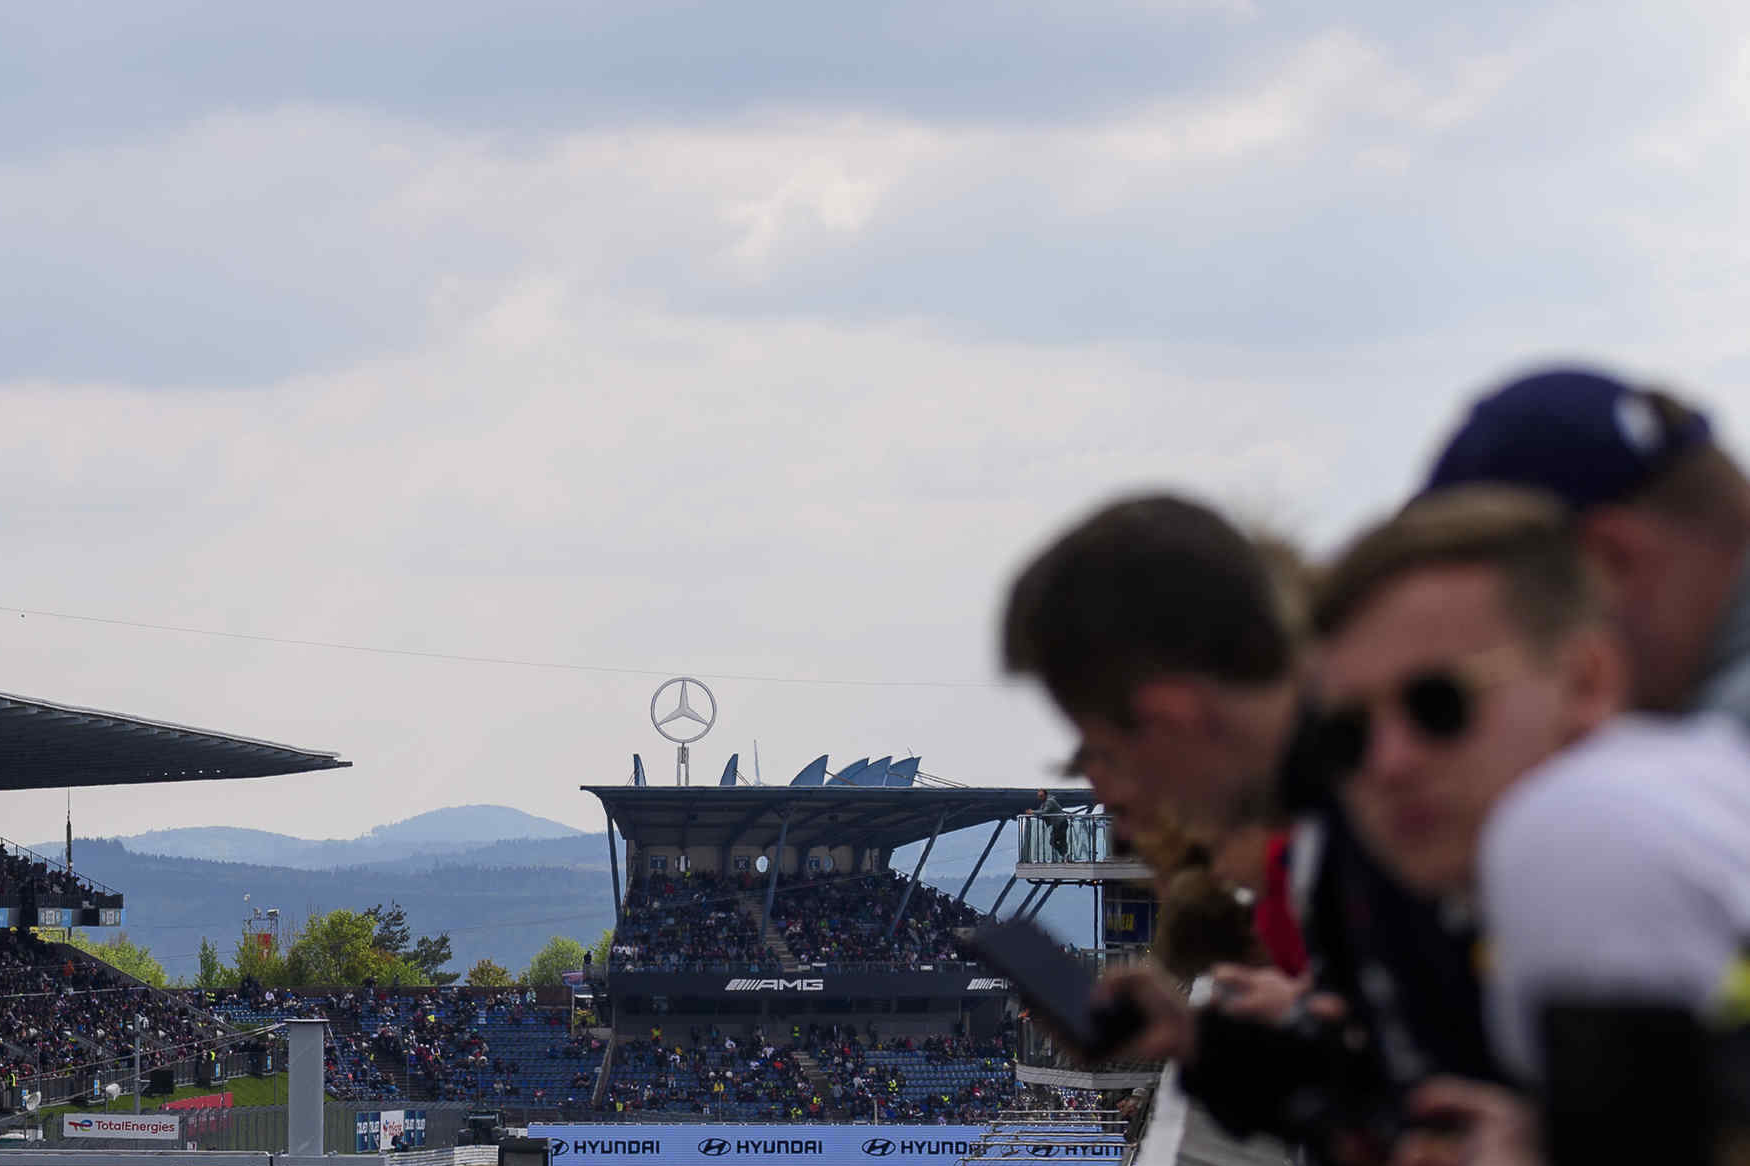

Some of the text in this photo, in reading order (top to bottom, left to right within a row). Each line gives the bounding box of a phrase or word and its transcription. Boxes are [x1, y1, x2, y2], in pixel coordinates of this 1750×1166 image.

[756, 979, 824, 991] AMG
[95, 1119, 175, 1134] TotalEnergies
[574, 1140, 660, 1155] HYUNDAI
[737, 1140, 823, 1155] HYUNDAI
